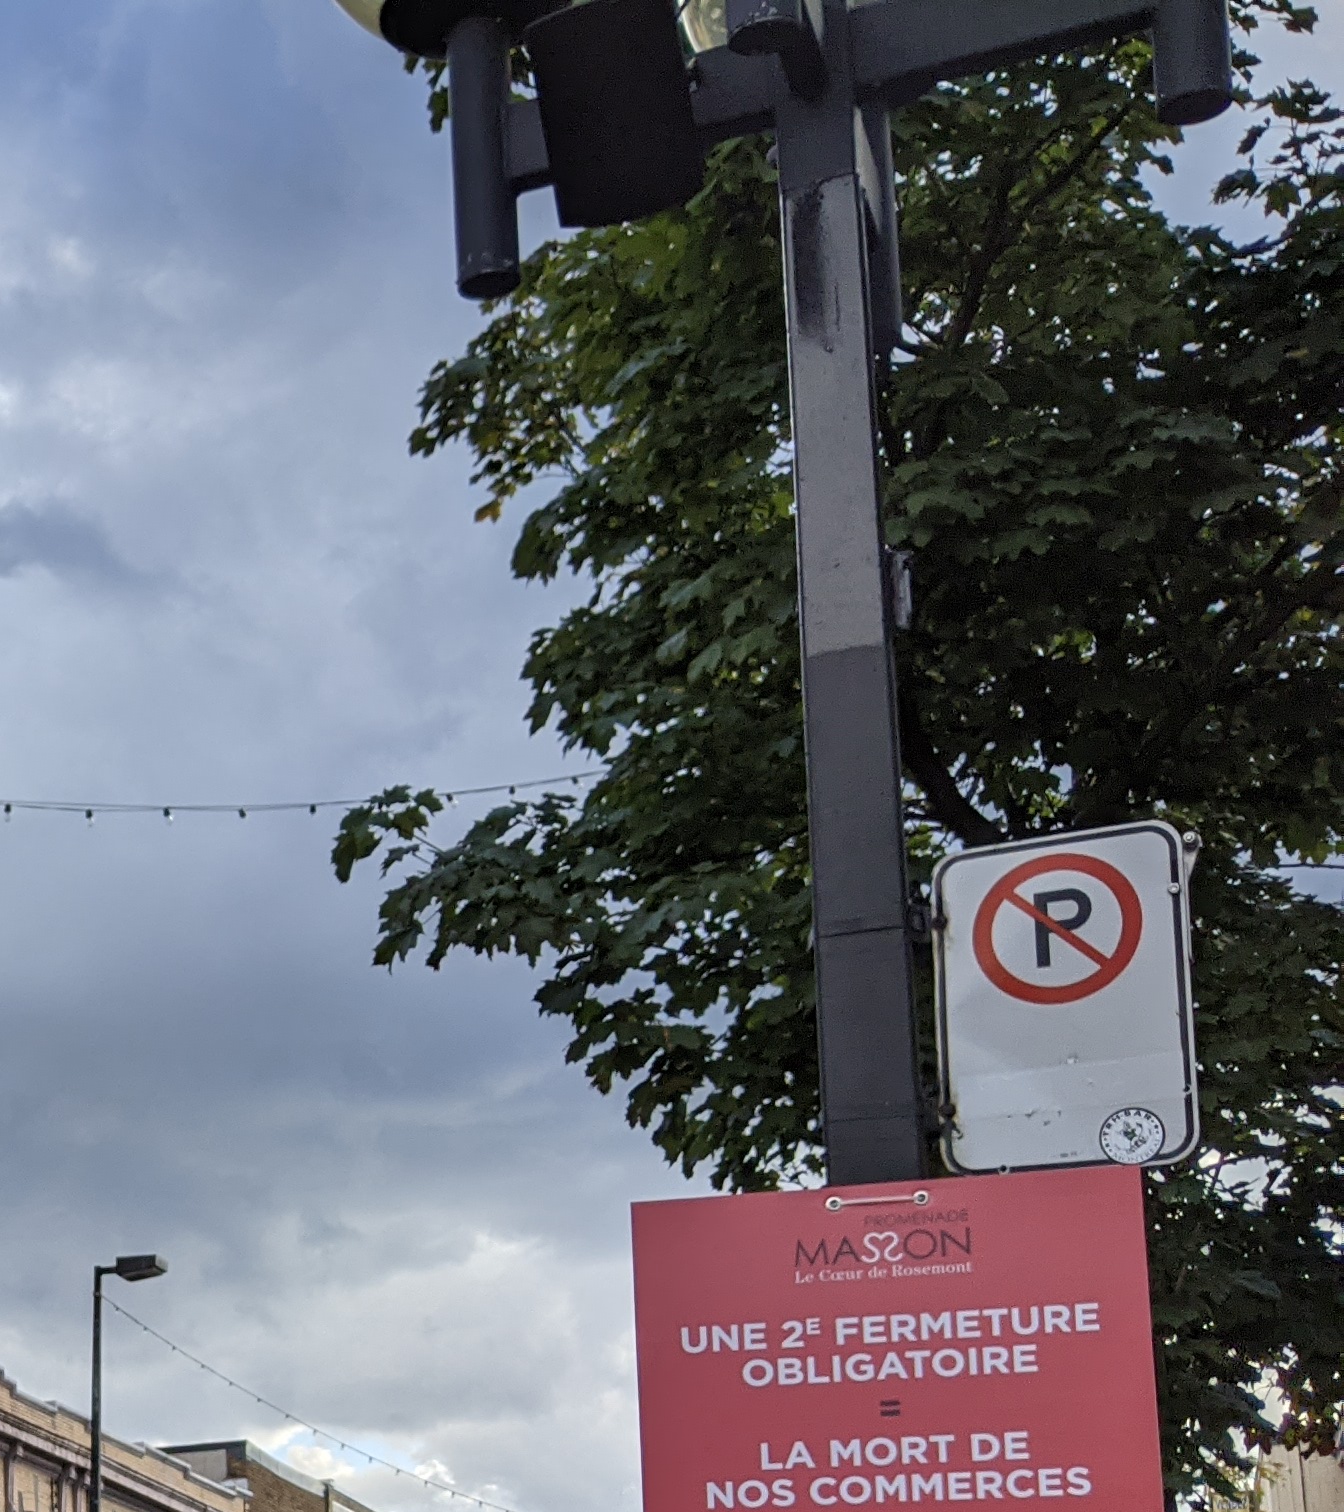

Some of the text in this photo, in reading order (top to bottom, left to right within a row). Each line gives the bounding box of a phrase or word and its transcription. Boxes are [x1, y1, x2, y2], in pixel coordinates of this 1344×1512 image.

[863, 1208, 970, 1227] PROMENADE
[794, 1226, 974, 1268] MASSON
[794, 1269, 815, 1285] Le
[867, 1265, 888, 1280] de
[892, 1260, 974, 1278] Rosemont
[680, 1323, 768, 1354] UNE
[834, 1302, 1101, 1346] FERMETURE
[742, 1344, 1039, 1388] OBLIGATOIRE
[760, 1430, 1030, 1471] LA MORT DE
[705, 1467, 1093, 1510] NOS COMMERCES
